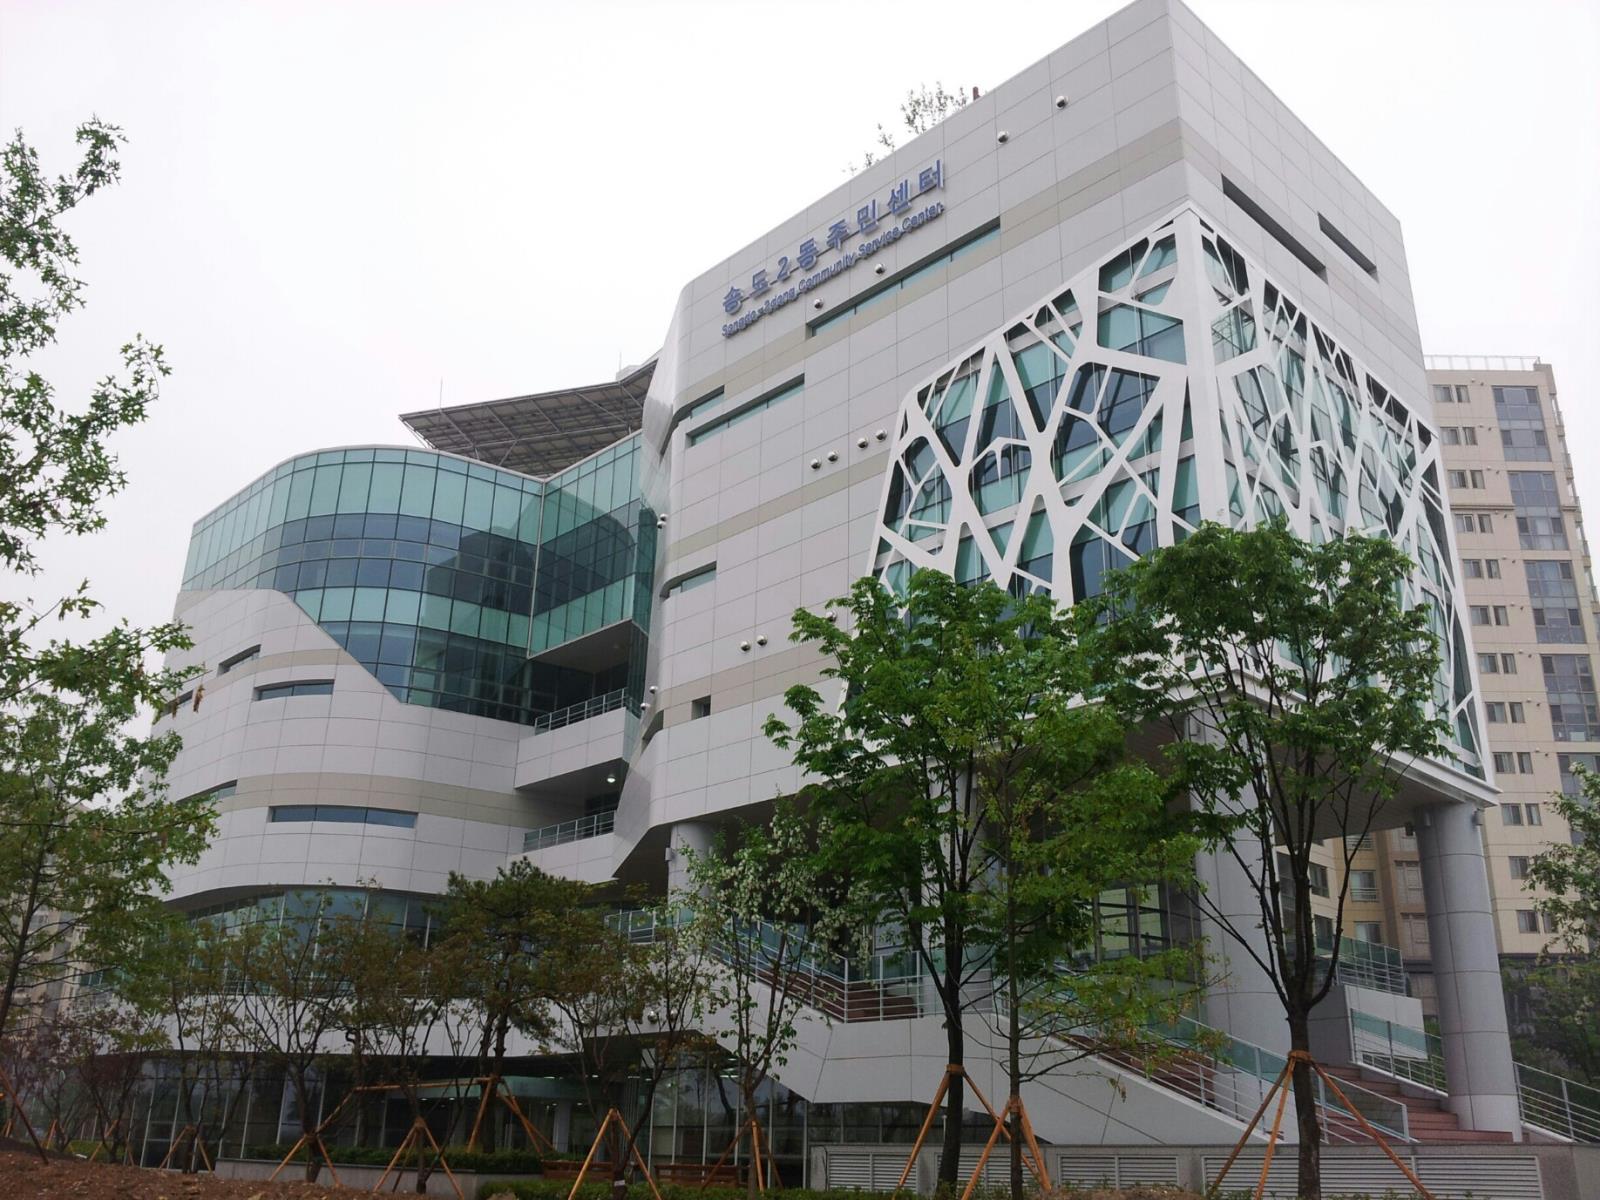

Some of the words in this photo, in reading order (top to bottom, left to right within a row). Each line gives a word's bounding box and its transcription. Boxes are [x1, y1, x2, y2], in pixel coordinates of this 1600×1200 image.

[798, 250, 857, 294] Community
[857, 226, 902, 259] Service
[901, 201, 945, 233] Center
